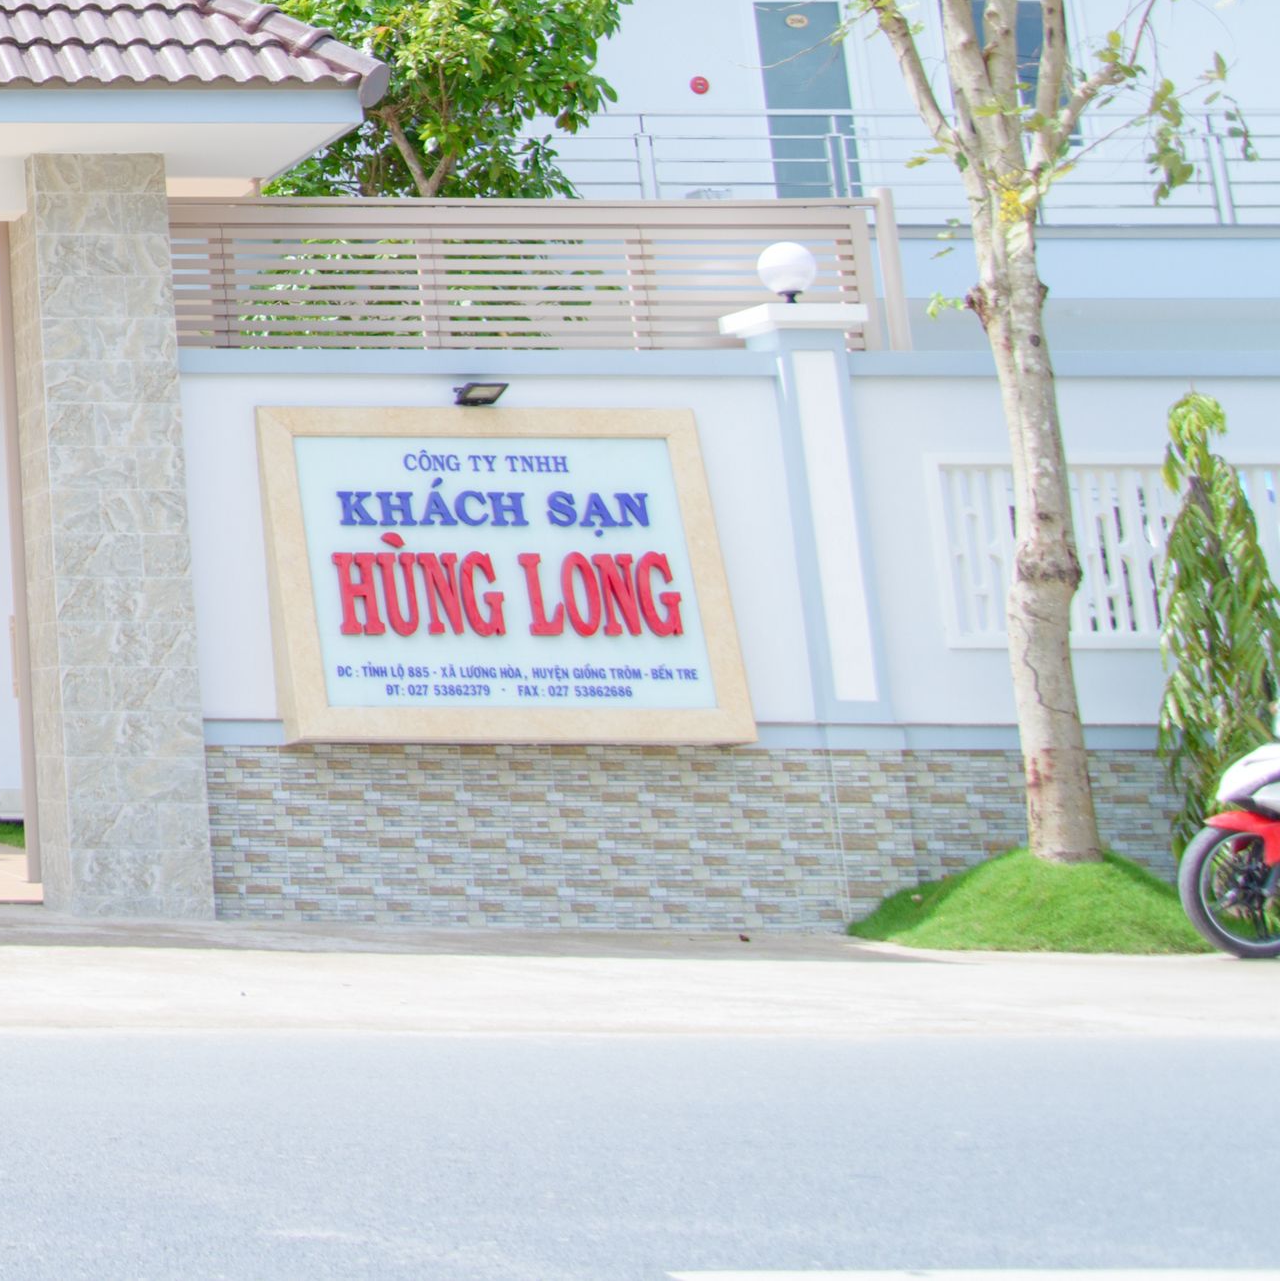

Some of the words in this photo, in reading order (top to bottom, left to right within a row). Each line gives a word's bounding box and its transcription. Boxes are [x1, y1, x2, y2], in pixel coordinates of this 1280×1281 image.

[402, 449, 461, 473] CÔNG
[467, 454, 497, 473] TY
[504, 454, 571, 474] TNHH
[335, 476, 530, 527] KHÁCH
[546, 489, 651, 538] SẠN
[330, 531, 507, 638] HÙNG
[517, 550, 684, 638] LONG
[361, 661, 388, 678] TỈNH
[391, 663, 405, 680] LỘ
[407, 666, 430, 678] 885
[441, 663, 456, 679] XÃ
[532, 664, 570, 682] HUYỆN
[610, 664, 642, 680] TRÔM
[651, 663, 674, 680] BẾN
[676, 667, 698, 680] TRE
[407, 684, 429, 696] 027
[433, 684, 491, 697] 53862379
[548, 685, 569, 697] 027
[574, 685, 633, 698] 53862686
